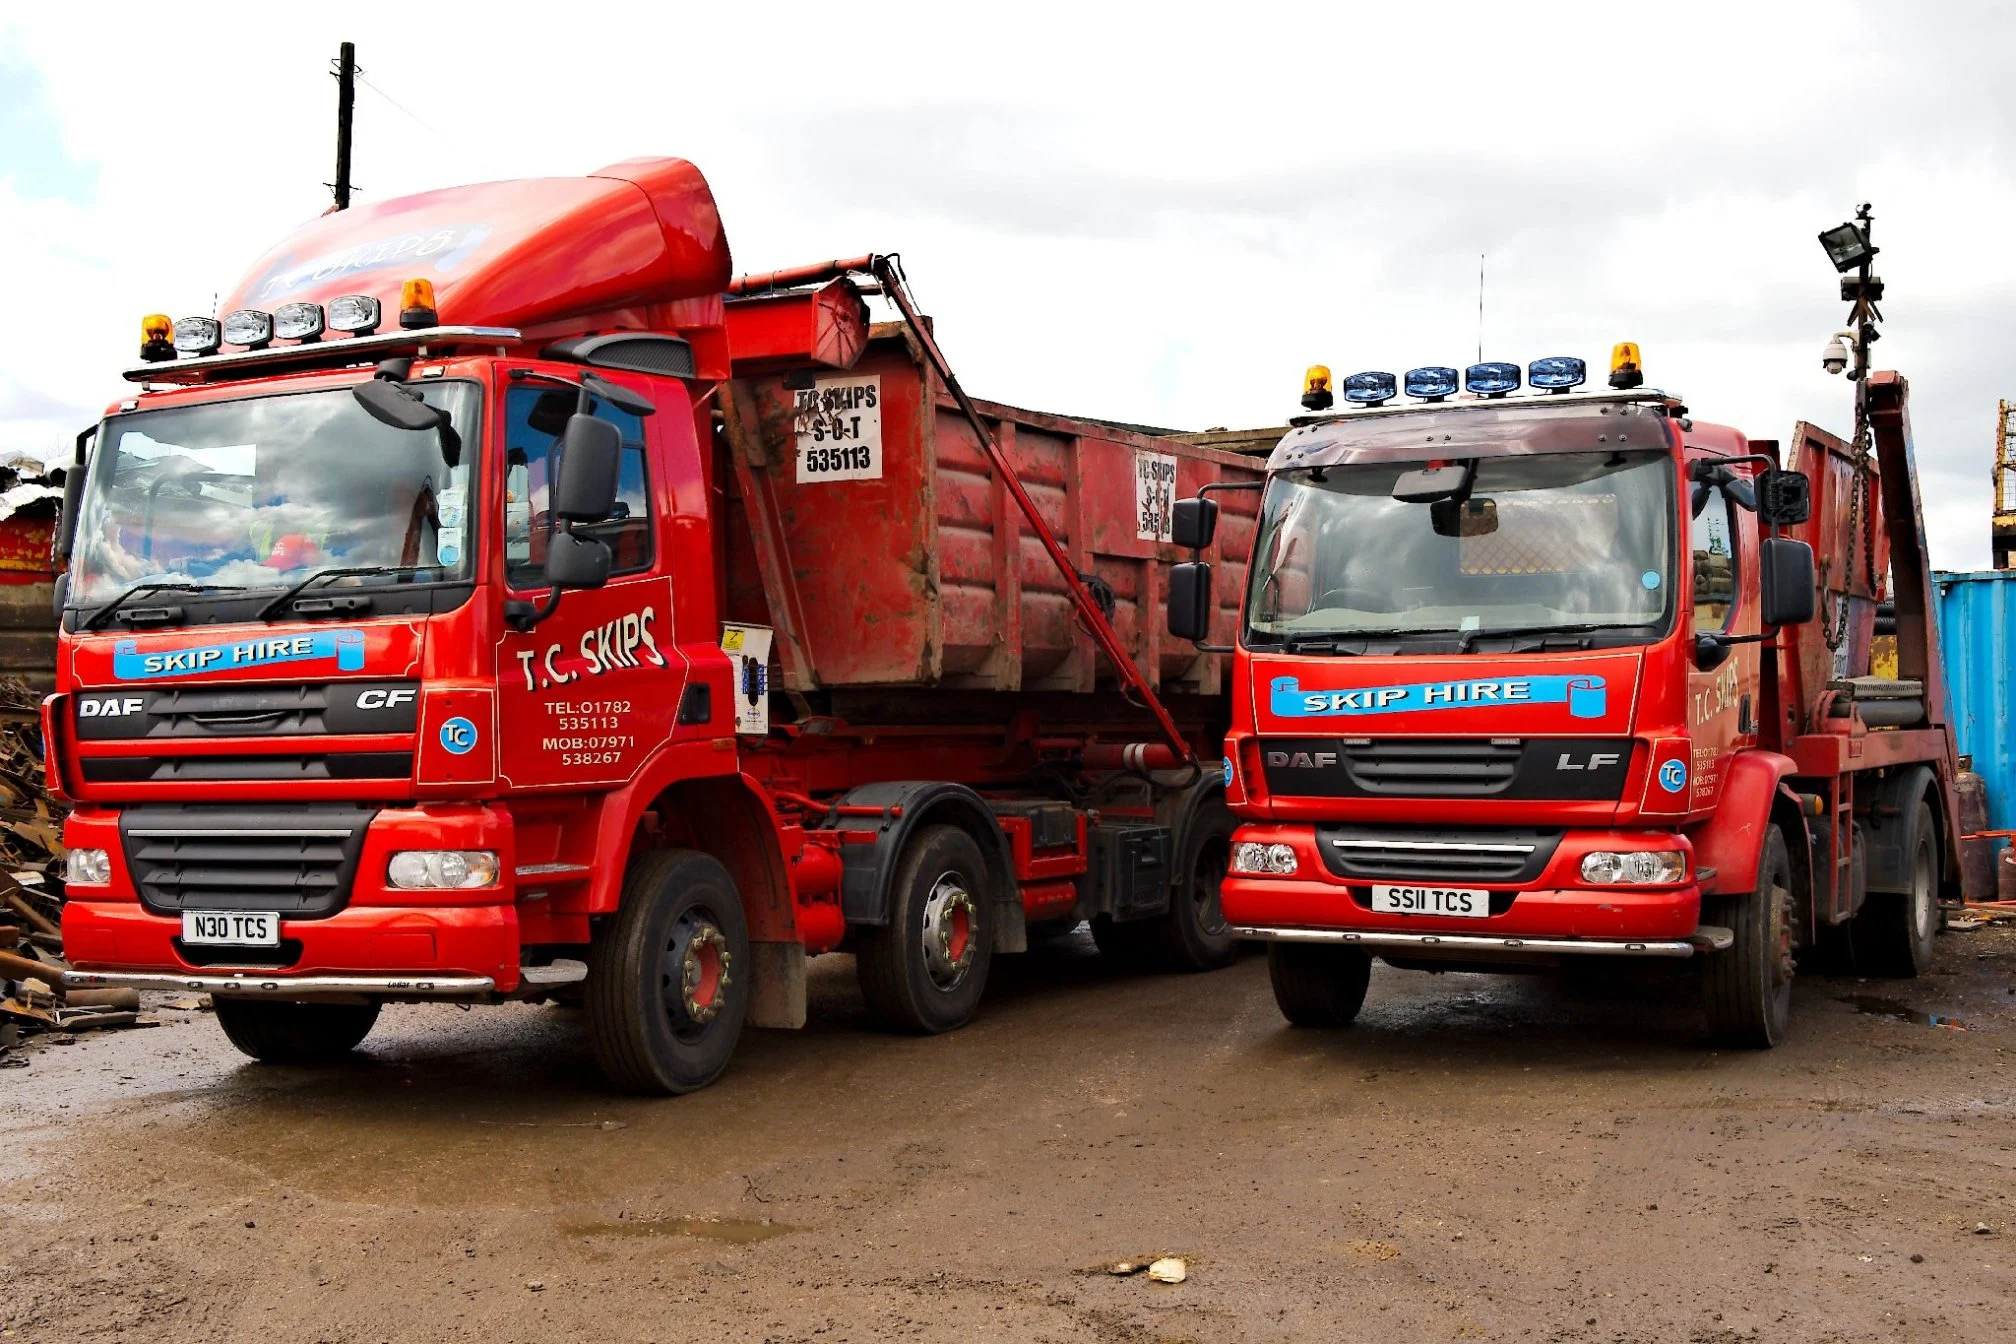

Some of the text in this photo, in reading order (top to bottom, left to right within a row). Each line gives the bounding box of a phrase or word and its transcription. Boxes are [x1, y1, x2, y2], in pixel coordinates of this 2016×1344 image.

[807, 446, 871, 472] 535113
[144, 637, 314, 673] SKIP HIRE
[517, 606, 665, 691] T.C. SKIPS
[80, 698, 143, 717] DAF
[356, 689, 416, 710] CF
[1303, 681, 1531, 713] SKIP HIRE
[559, 716, 618, 730] 535113
[445, 724, 469, 747] TC
[542, 735, 634, 750] MOB:07971
[562, 751, 621, 766] 538267
[1267, 752, 1336, 769] DAF
[1556, 754, 1620, 770] LF
[1663, 765, 1682, 786] TC
[1432, 890, 1473, 913] TCS
[233, 917, 267, 939] TCS
